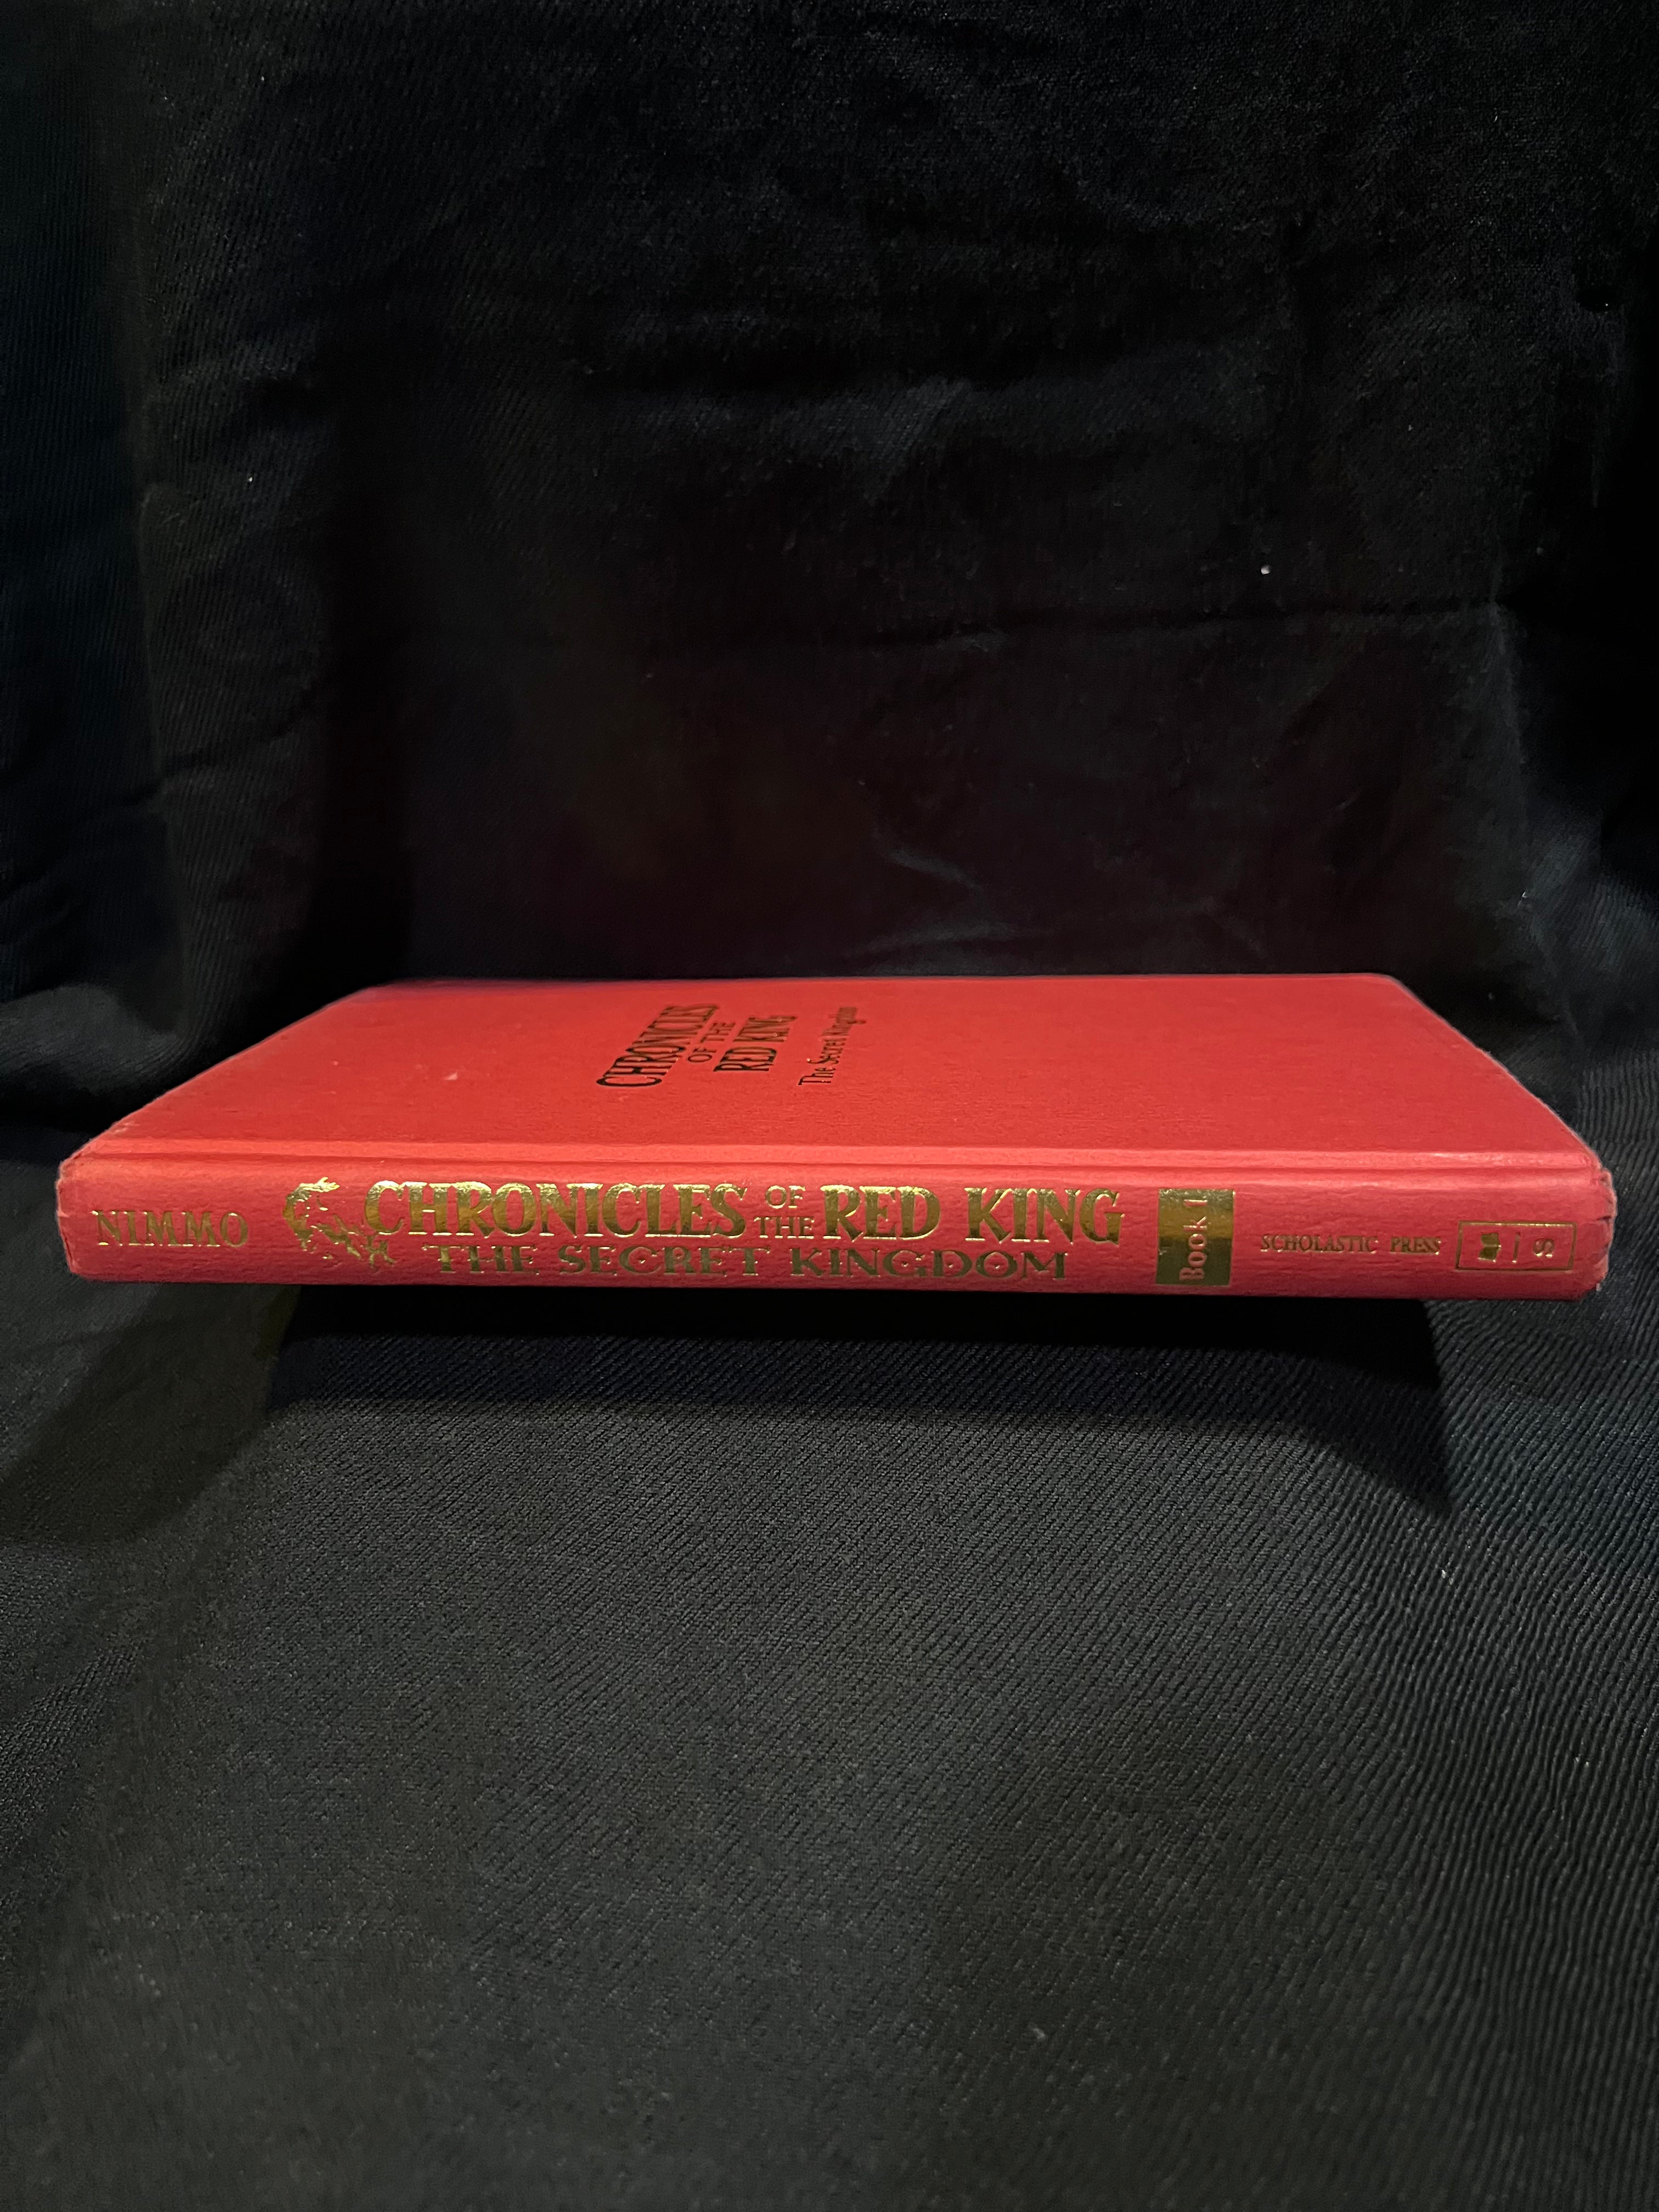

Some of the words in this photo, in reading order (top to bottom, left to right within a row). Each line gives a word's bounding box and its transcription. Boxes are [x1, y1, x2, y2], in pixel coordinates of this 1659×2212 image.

[700, 1022, 736, 1043] THE
[733, 1016, 797, 1042] KING
[596, 1003, 719, 1086] CHRONICLES
[688, 1046, 717, 1063] OF
[806, 1038, 847, 1064] Secret
[713, 1046, 777, 1071] RED
[798, 1068, 836, 1086] The
[364, 1180, 748, 1238] CHRONICLES
[765, 1185, 806, 1209] OF
[820, 1184, 941, 1242] RED
[964, 1187, 1126, 1245] KING
[92, 1210, 249, 1248] NIMMO
[754, 1216, 815, 1239] THE
[1180, 1216, 1207, 1281] Book
[1261, 1234, 1379, 1255] SCHOLASTIC
[1390, 1236, 1442, 1256] PRESS
[422, 1243, 540, 1275] THE
[557, 1244, 771, 1277] SECRET
[789, 1248, 1069, 1280] KINGDOM
